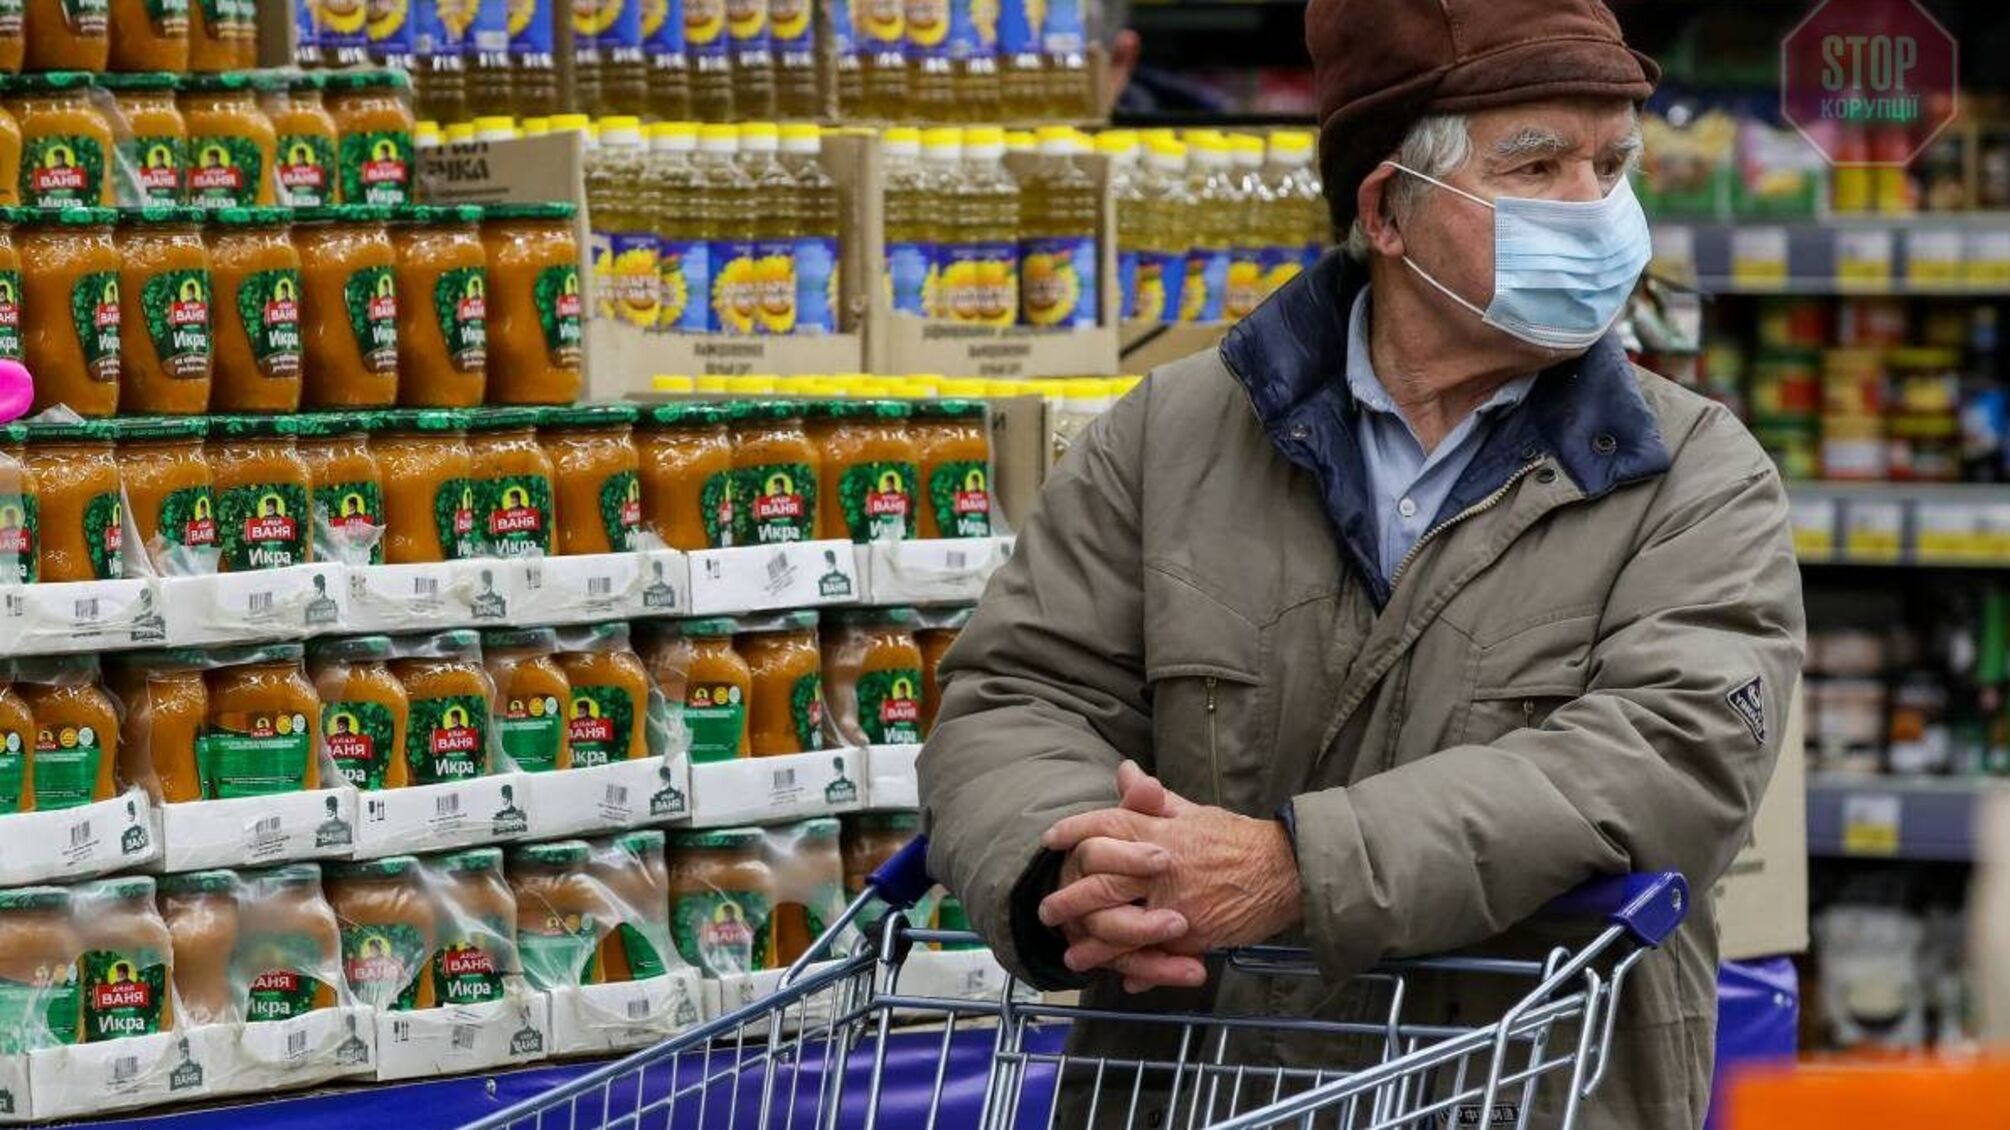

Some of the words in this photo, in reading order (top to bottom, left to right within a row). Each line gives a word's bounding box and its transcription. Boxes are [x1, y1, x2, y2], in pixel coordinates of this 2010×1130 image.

[173, 331, 207, 352] Икра
[760, 503, 798, 516] ВАНЯ
[498, 515, 535, 529] ВАНЯ
[252, 525, 291, 539] ВАНЯ
[758, 524, 800, 542] Икра
[249, 547, 292, 569] Икра
[437, 736, 473, 749] ВАНЯ
[435, 759, 474, 778] Икра
[449, 957, 495, 972] ВАНЯ
[249, 976, 290, 988] АНЯ
[447, 980, 492, 999] Икра
[102, 991, 144, 1005] ВАНЯ
[99, 1014, 146, 1034] Икра
